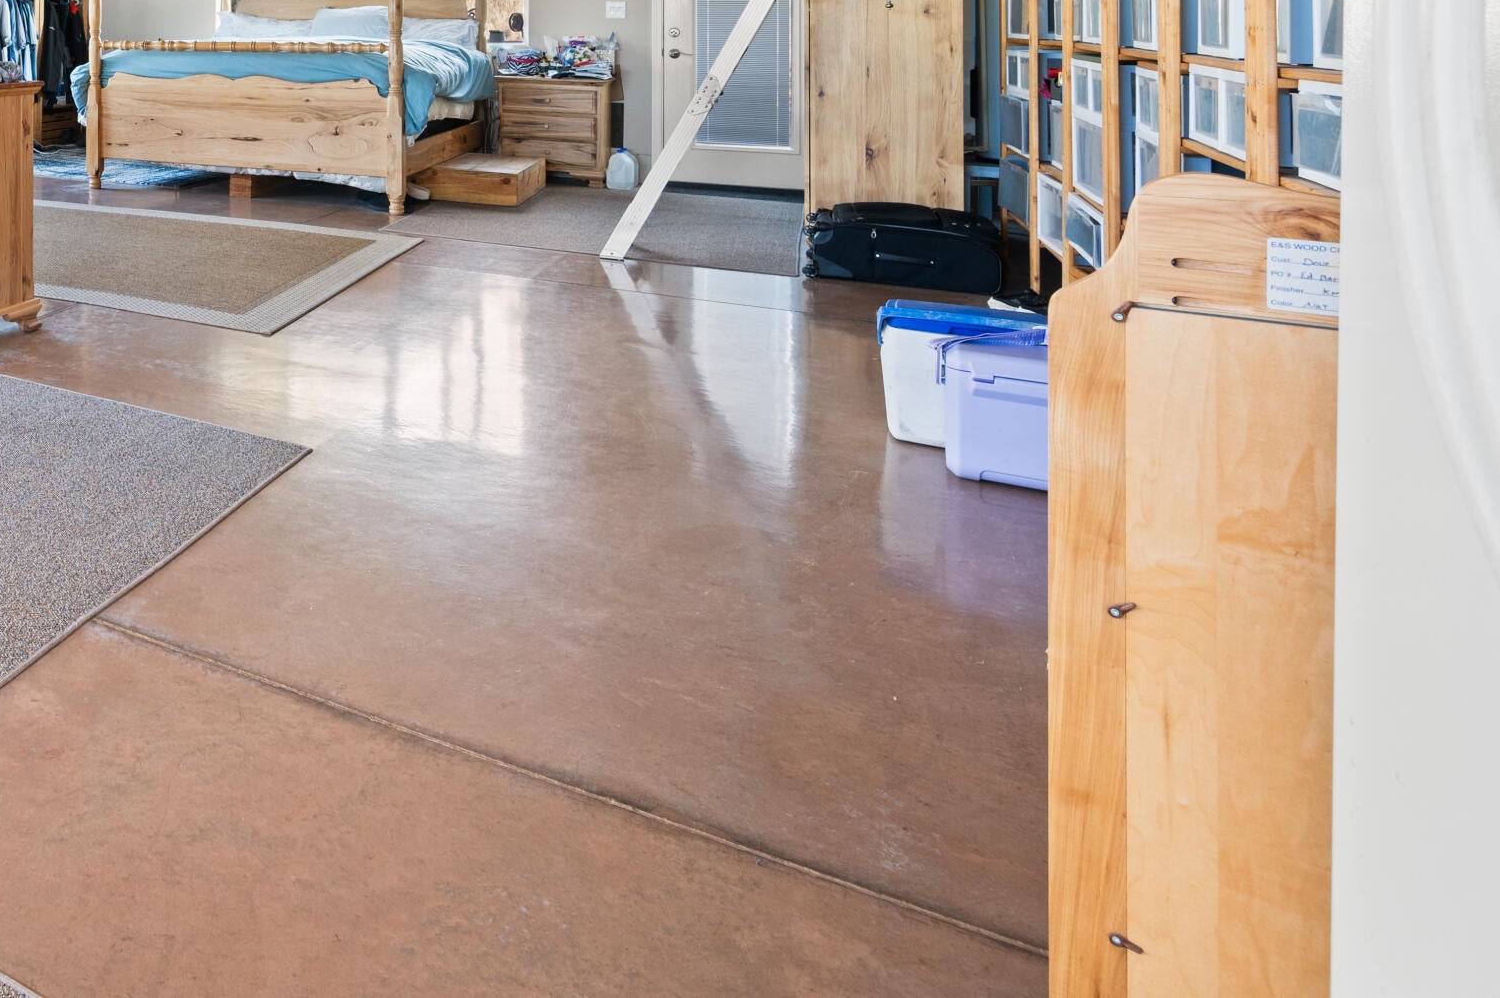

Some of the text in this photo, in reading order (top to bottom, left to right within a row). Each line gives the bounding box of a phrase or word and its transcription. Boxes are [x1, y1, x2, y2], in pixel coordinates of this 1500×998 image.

[1270, 241, 1291, 249] E&S
[1293, 243, 1327, 252] WOOD
[1270, 284, 1304, 293] Finisher
